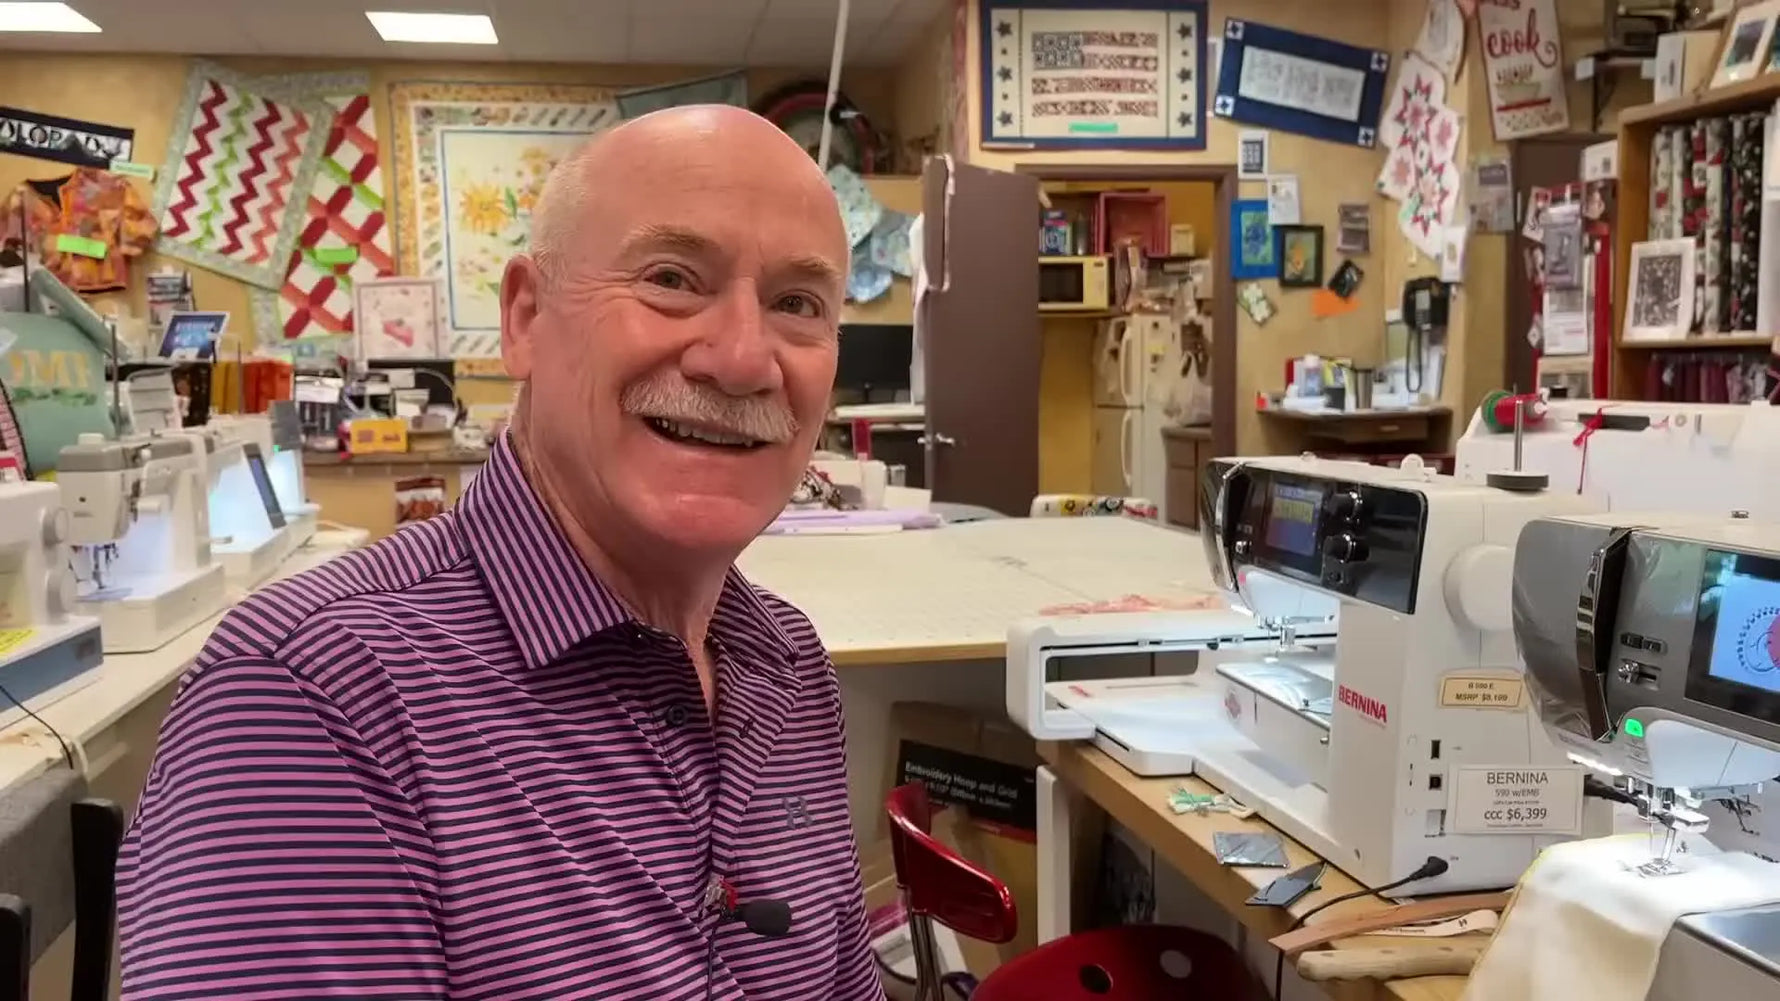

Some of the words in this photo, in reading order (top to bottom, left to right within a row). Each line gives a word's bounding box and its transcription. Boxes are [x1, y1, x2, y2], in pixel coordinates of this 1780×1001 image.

[1487, 7, 1558, 69] cook
[1338, 684, 1387, 724] BERNINA
[1455, 692, 1479, 701] MSRP
[905, 760, 952, 784] Embroidery
[953, 773, 977, 791] Hoop
[979, 782, 996, 794] and
[1486, 771, 1549, 785] BERNINA
[1506, 807, 1548, 821] $6,399
